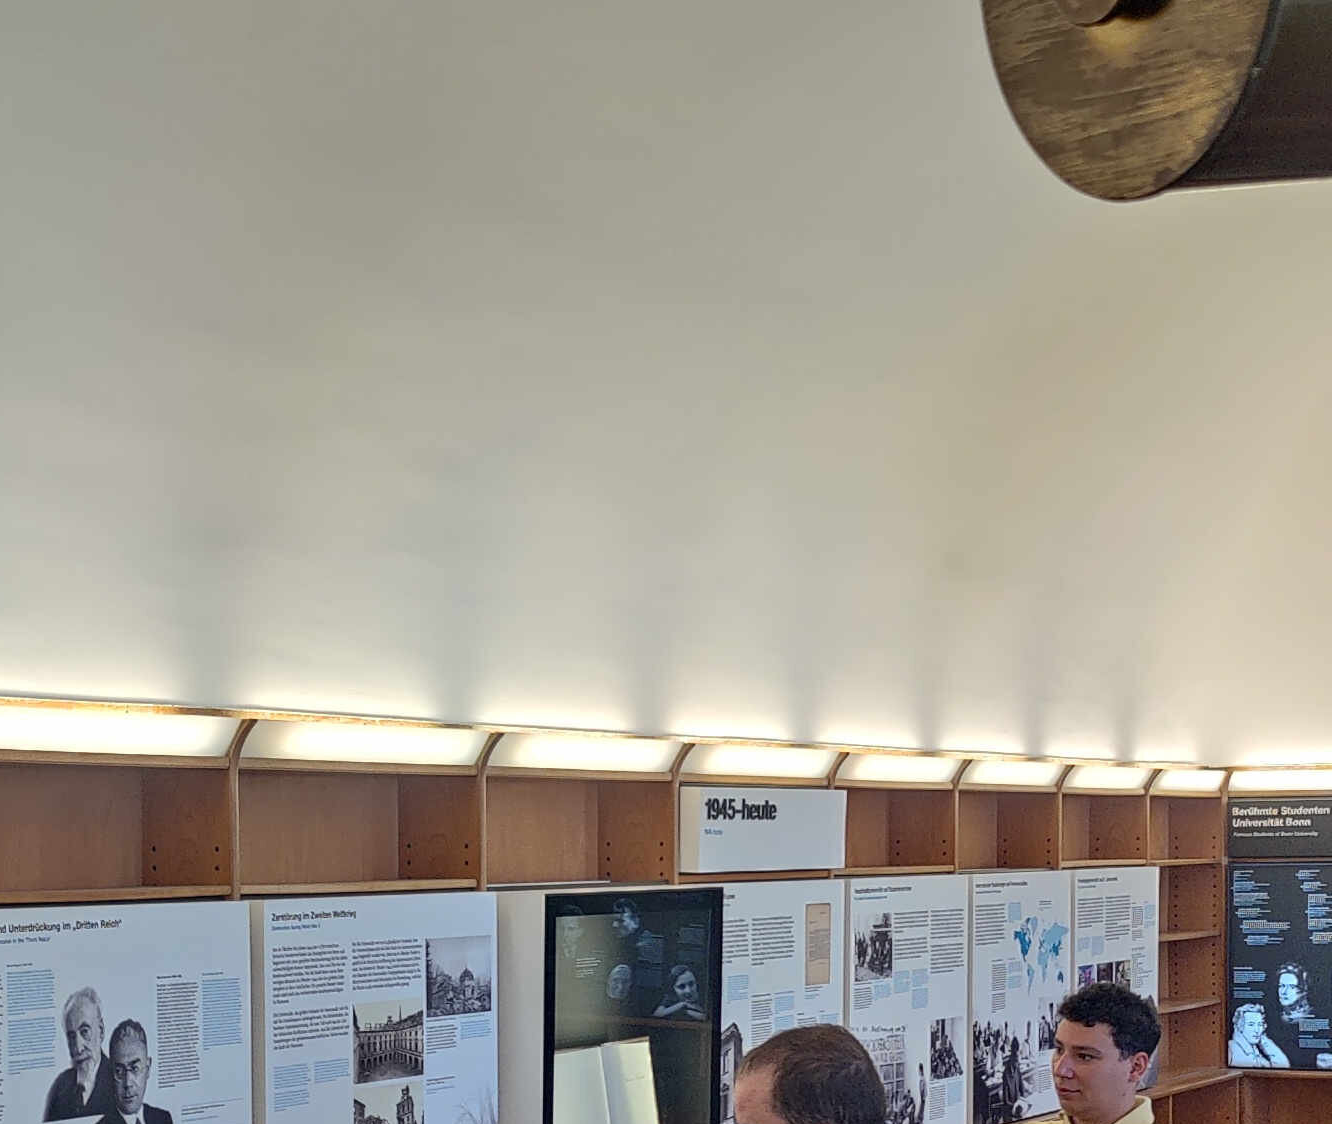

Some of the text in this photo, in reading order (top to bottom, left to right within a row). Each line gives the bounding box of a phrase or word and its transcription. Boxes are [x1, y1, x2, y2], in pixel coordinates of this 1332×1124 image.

[1232, 807, 1278, 816] Berühmte
[1281, 806, 1330, 815] Studenten
[1233, 817, 1311, 827] Universität Bonn
[9, 922, 60, 933] Unterdrückung
[63, 921, 71, 930] im
[73, 920, 99, 931] „Dritten
